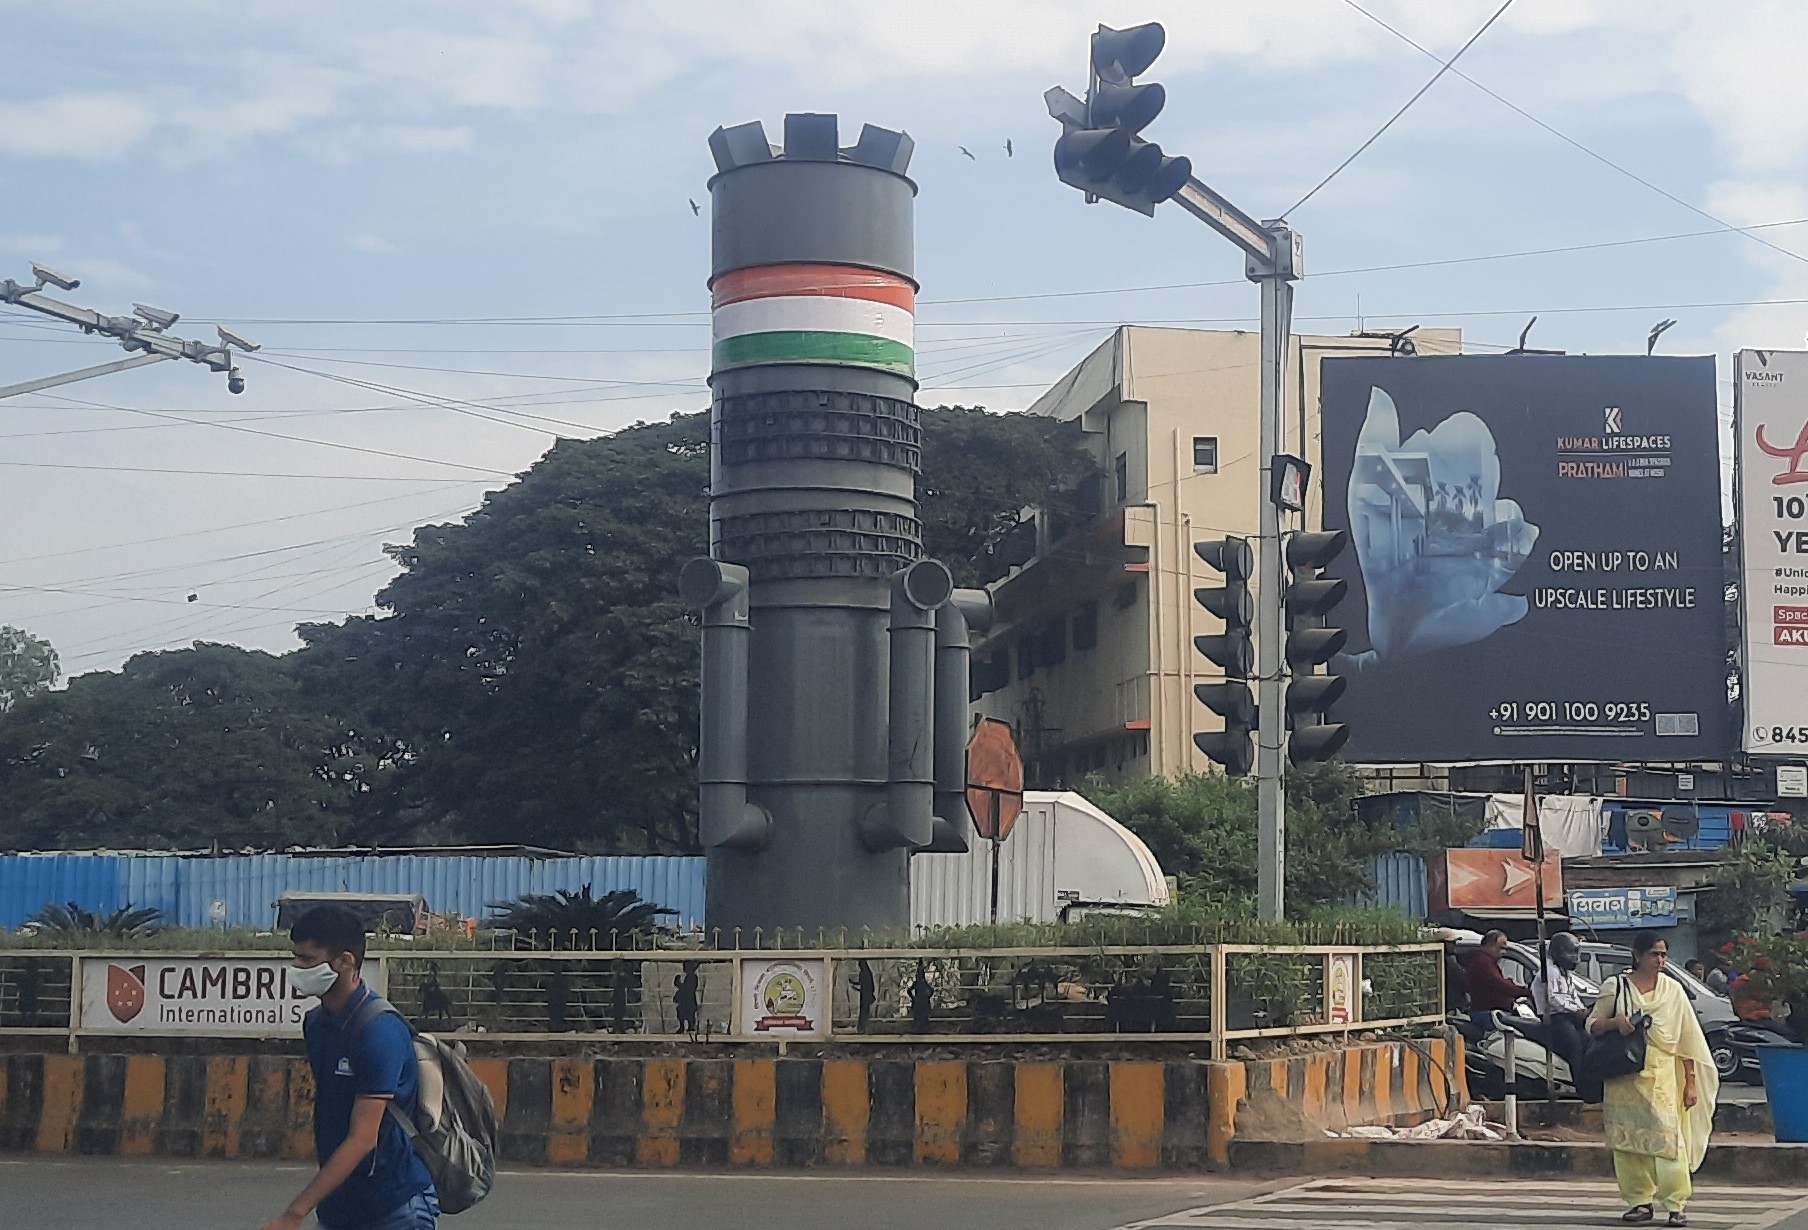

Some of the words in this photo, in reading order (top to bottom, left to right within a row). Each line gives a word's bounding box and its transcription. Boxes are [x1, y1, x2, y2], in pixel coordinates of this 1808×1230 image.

[1745, 371, 1784, 383] VASANT
[1557, 436, 1599, 450] KUMAR
[1602, 435, 1671, 450] LIFESPACES
[1558, 461, 1624, 478] PRATHAM
[1773, 493, 1808, 519] 10
[1550, 551, 1596, 571] OPEN
[1601, 551, 1622, 571] UP
[1627, 551, 1649, 571] TO
[1654, 551, 1678, 570] AN
[1535, 588, 1607, 609] UPSCALE
[1612, 588, 1695, 609] LIFESTYLE
[1489, 702, 1518, 721] +91
[1525, 702, 1557, 721] 901
[1564, 702, 1599, 721] 100
[1605, 702, 1650, 721] 9235
[1771, 726, 1808, 743] 845
[160, 1004, 283, 1024] International
[290, 1005, 302, 1024] S
